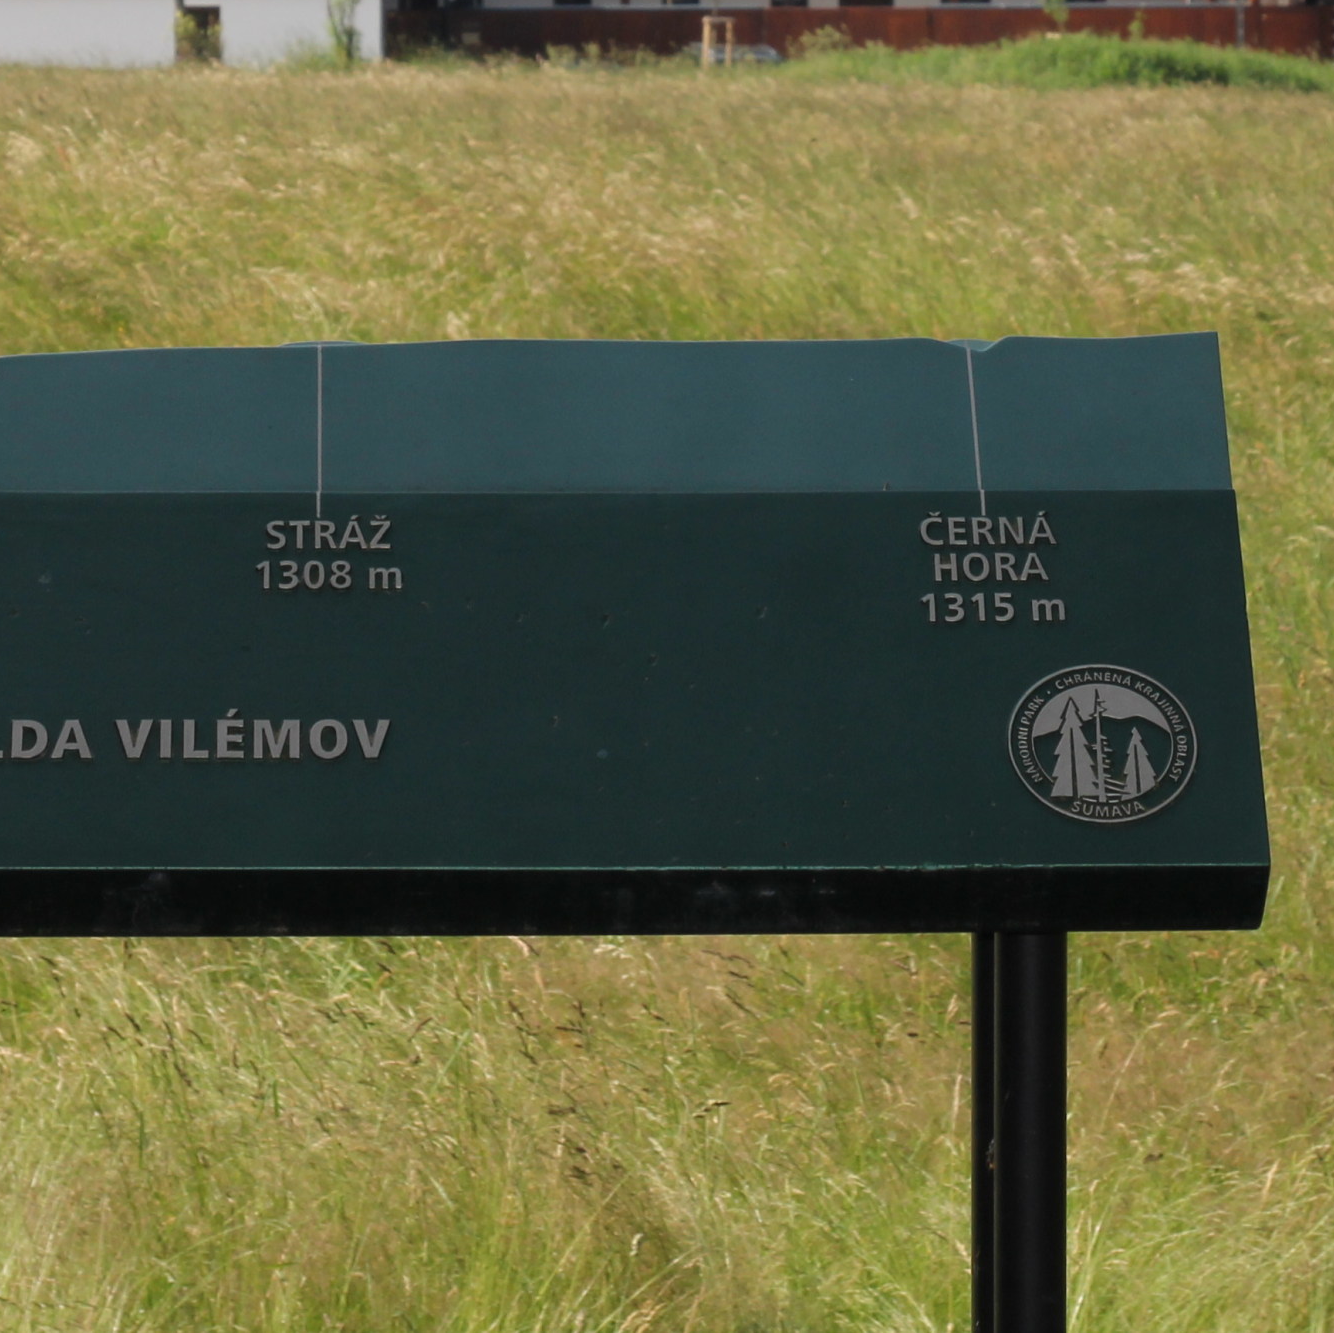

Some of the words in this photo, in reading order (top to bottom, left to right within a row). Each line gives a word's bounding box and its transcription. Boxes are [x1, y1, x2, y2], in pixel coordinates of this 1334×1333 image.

[265, 514, 392, 551] STRÁŽ
[919, 509, 1058, 547] ČERNÁ
[255, 560, 353, 591] 1308
[368, 566, 404, 591] m
[932, 552, 1050, 582] HORA
[920, 592, 1016, 623] 1315
[1030, 597, 1067, 622] m
[115, 708, 391, 760] VILÉMOV
[1020, 695, 1045, 725] PARK
[1169, 735, 1187, 783] OBLAST
